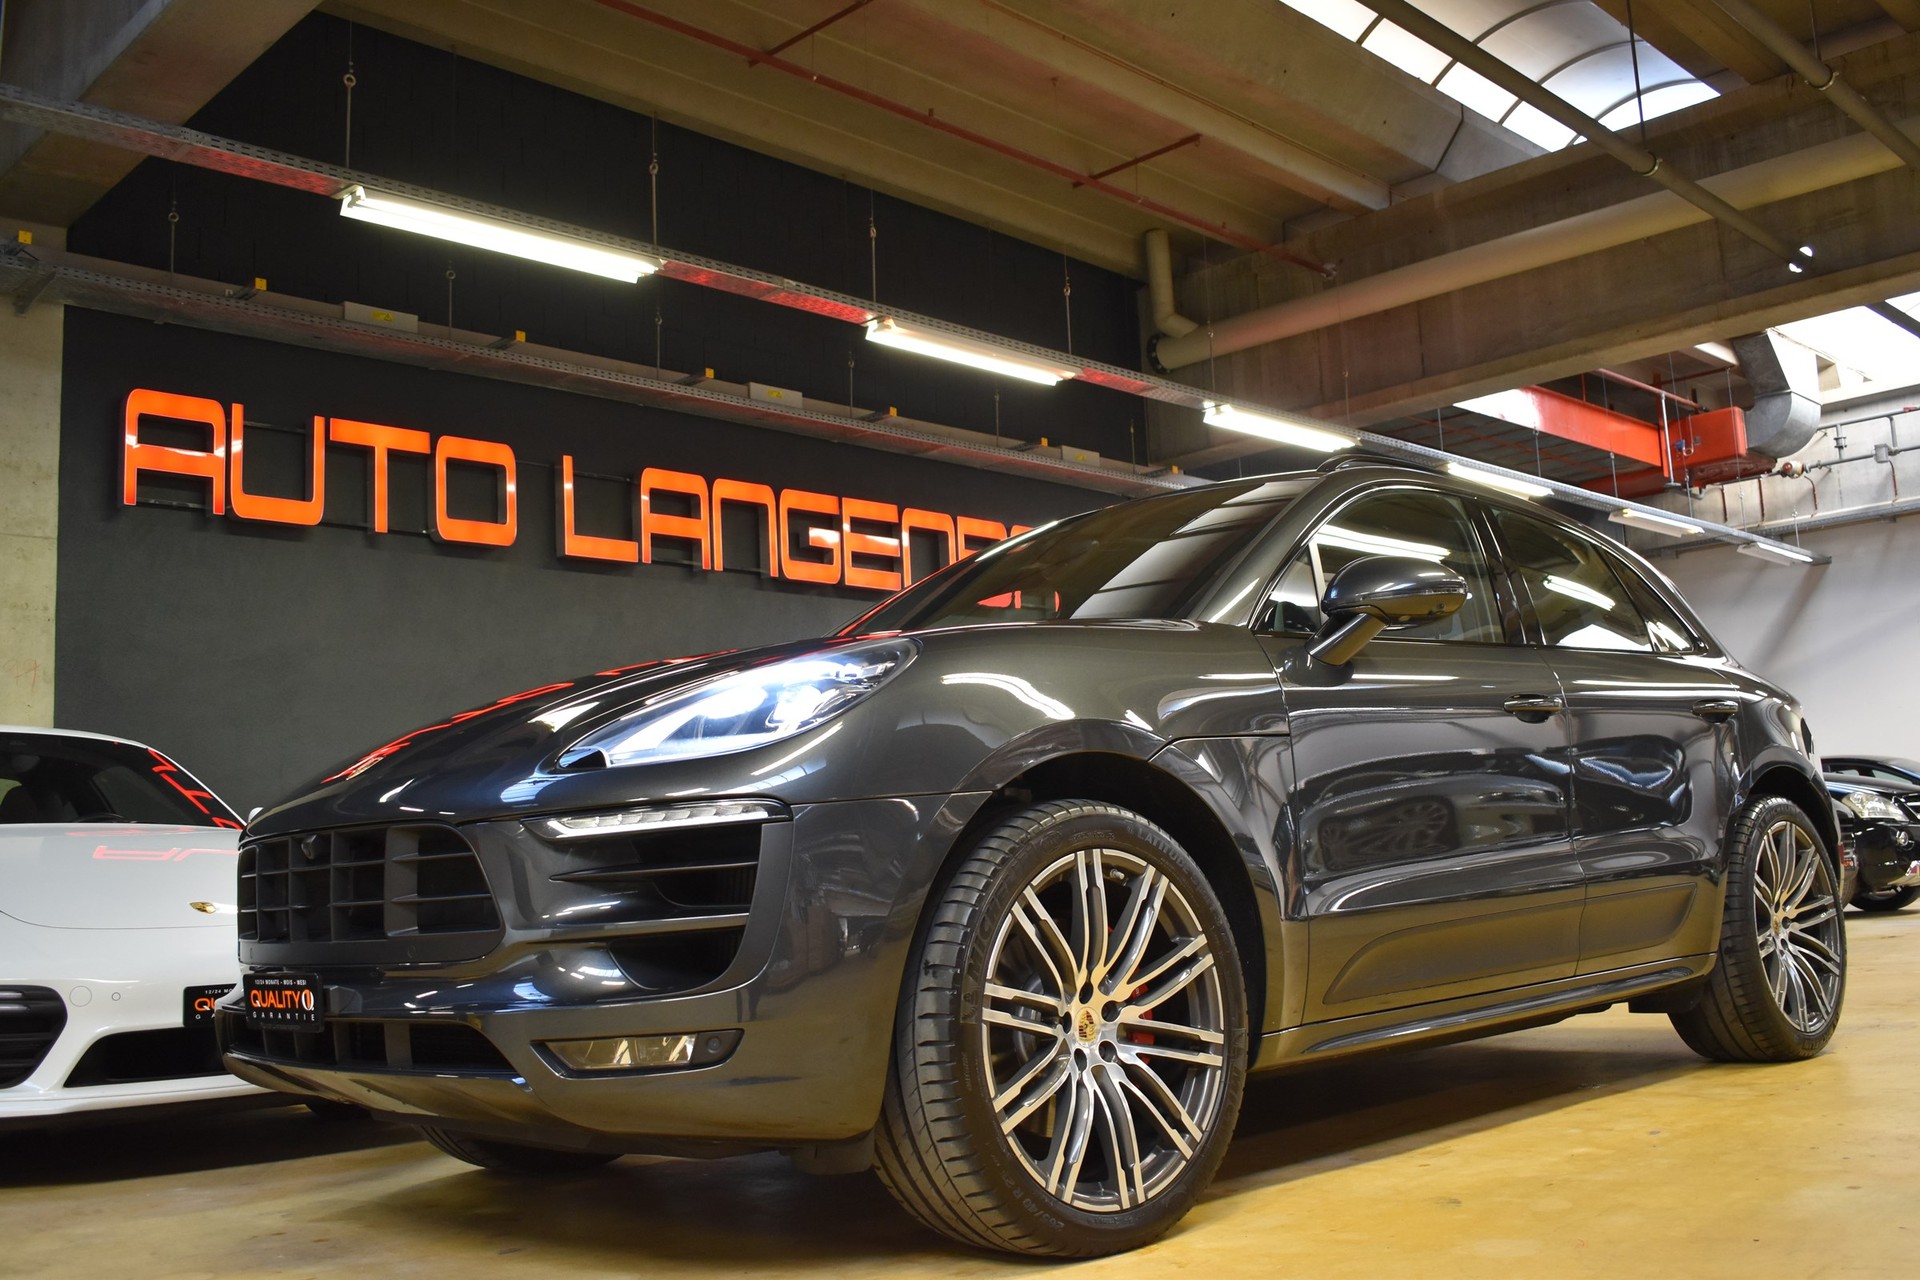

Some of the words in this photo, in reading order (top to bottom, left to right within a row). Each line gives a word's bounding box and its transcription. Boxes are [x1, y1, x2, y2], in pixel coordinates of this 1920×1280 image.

[123, 388, 517, 546] AUTO
[562, 455, 1032, 592] LANGEN
[250, 989, 301, 1008] QUALITY
[252, 1011, 315, 1021] GARANTIE
